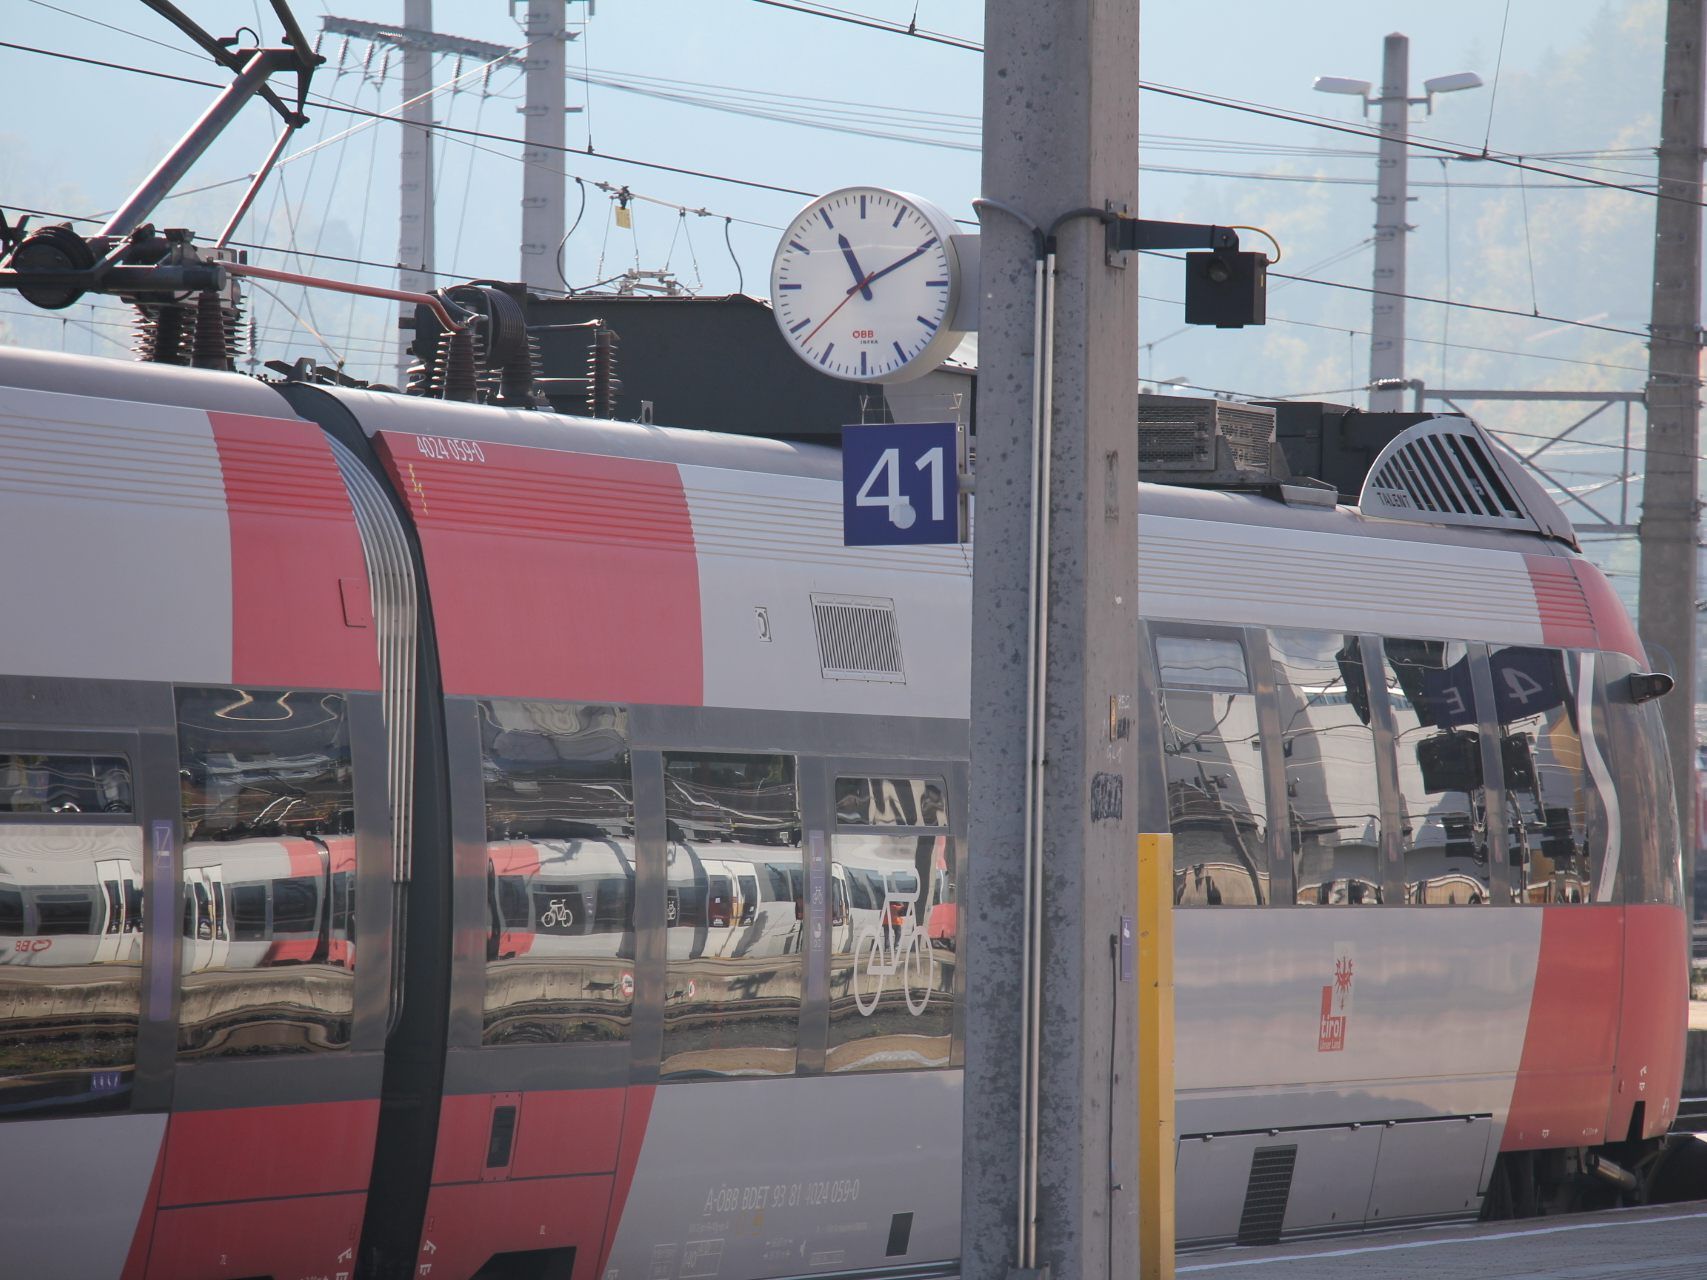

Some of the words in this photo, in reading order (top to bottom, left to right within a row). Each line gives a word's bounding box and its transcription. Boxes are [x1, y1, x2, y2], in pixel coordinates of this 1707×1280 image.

[416, 436, 450, 460] 4024
[447, 440, 485, 463] 059-0
[856, 447, 944, 522] 41
[1376, 491, 1411, 508] TALENT
[1321, 1014, 1342, 1038] tirol
[770, 1183, 787, 1208] 93
[788, 1182, 802, 1207] 81
[831, 1178, 860, 1204] 059-0
